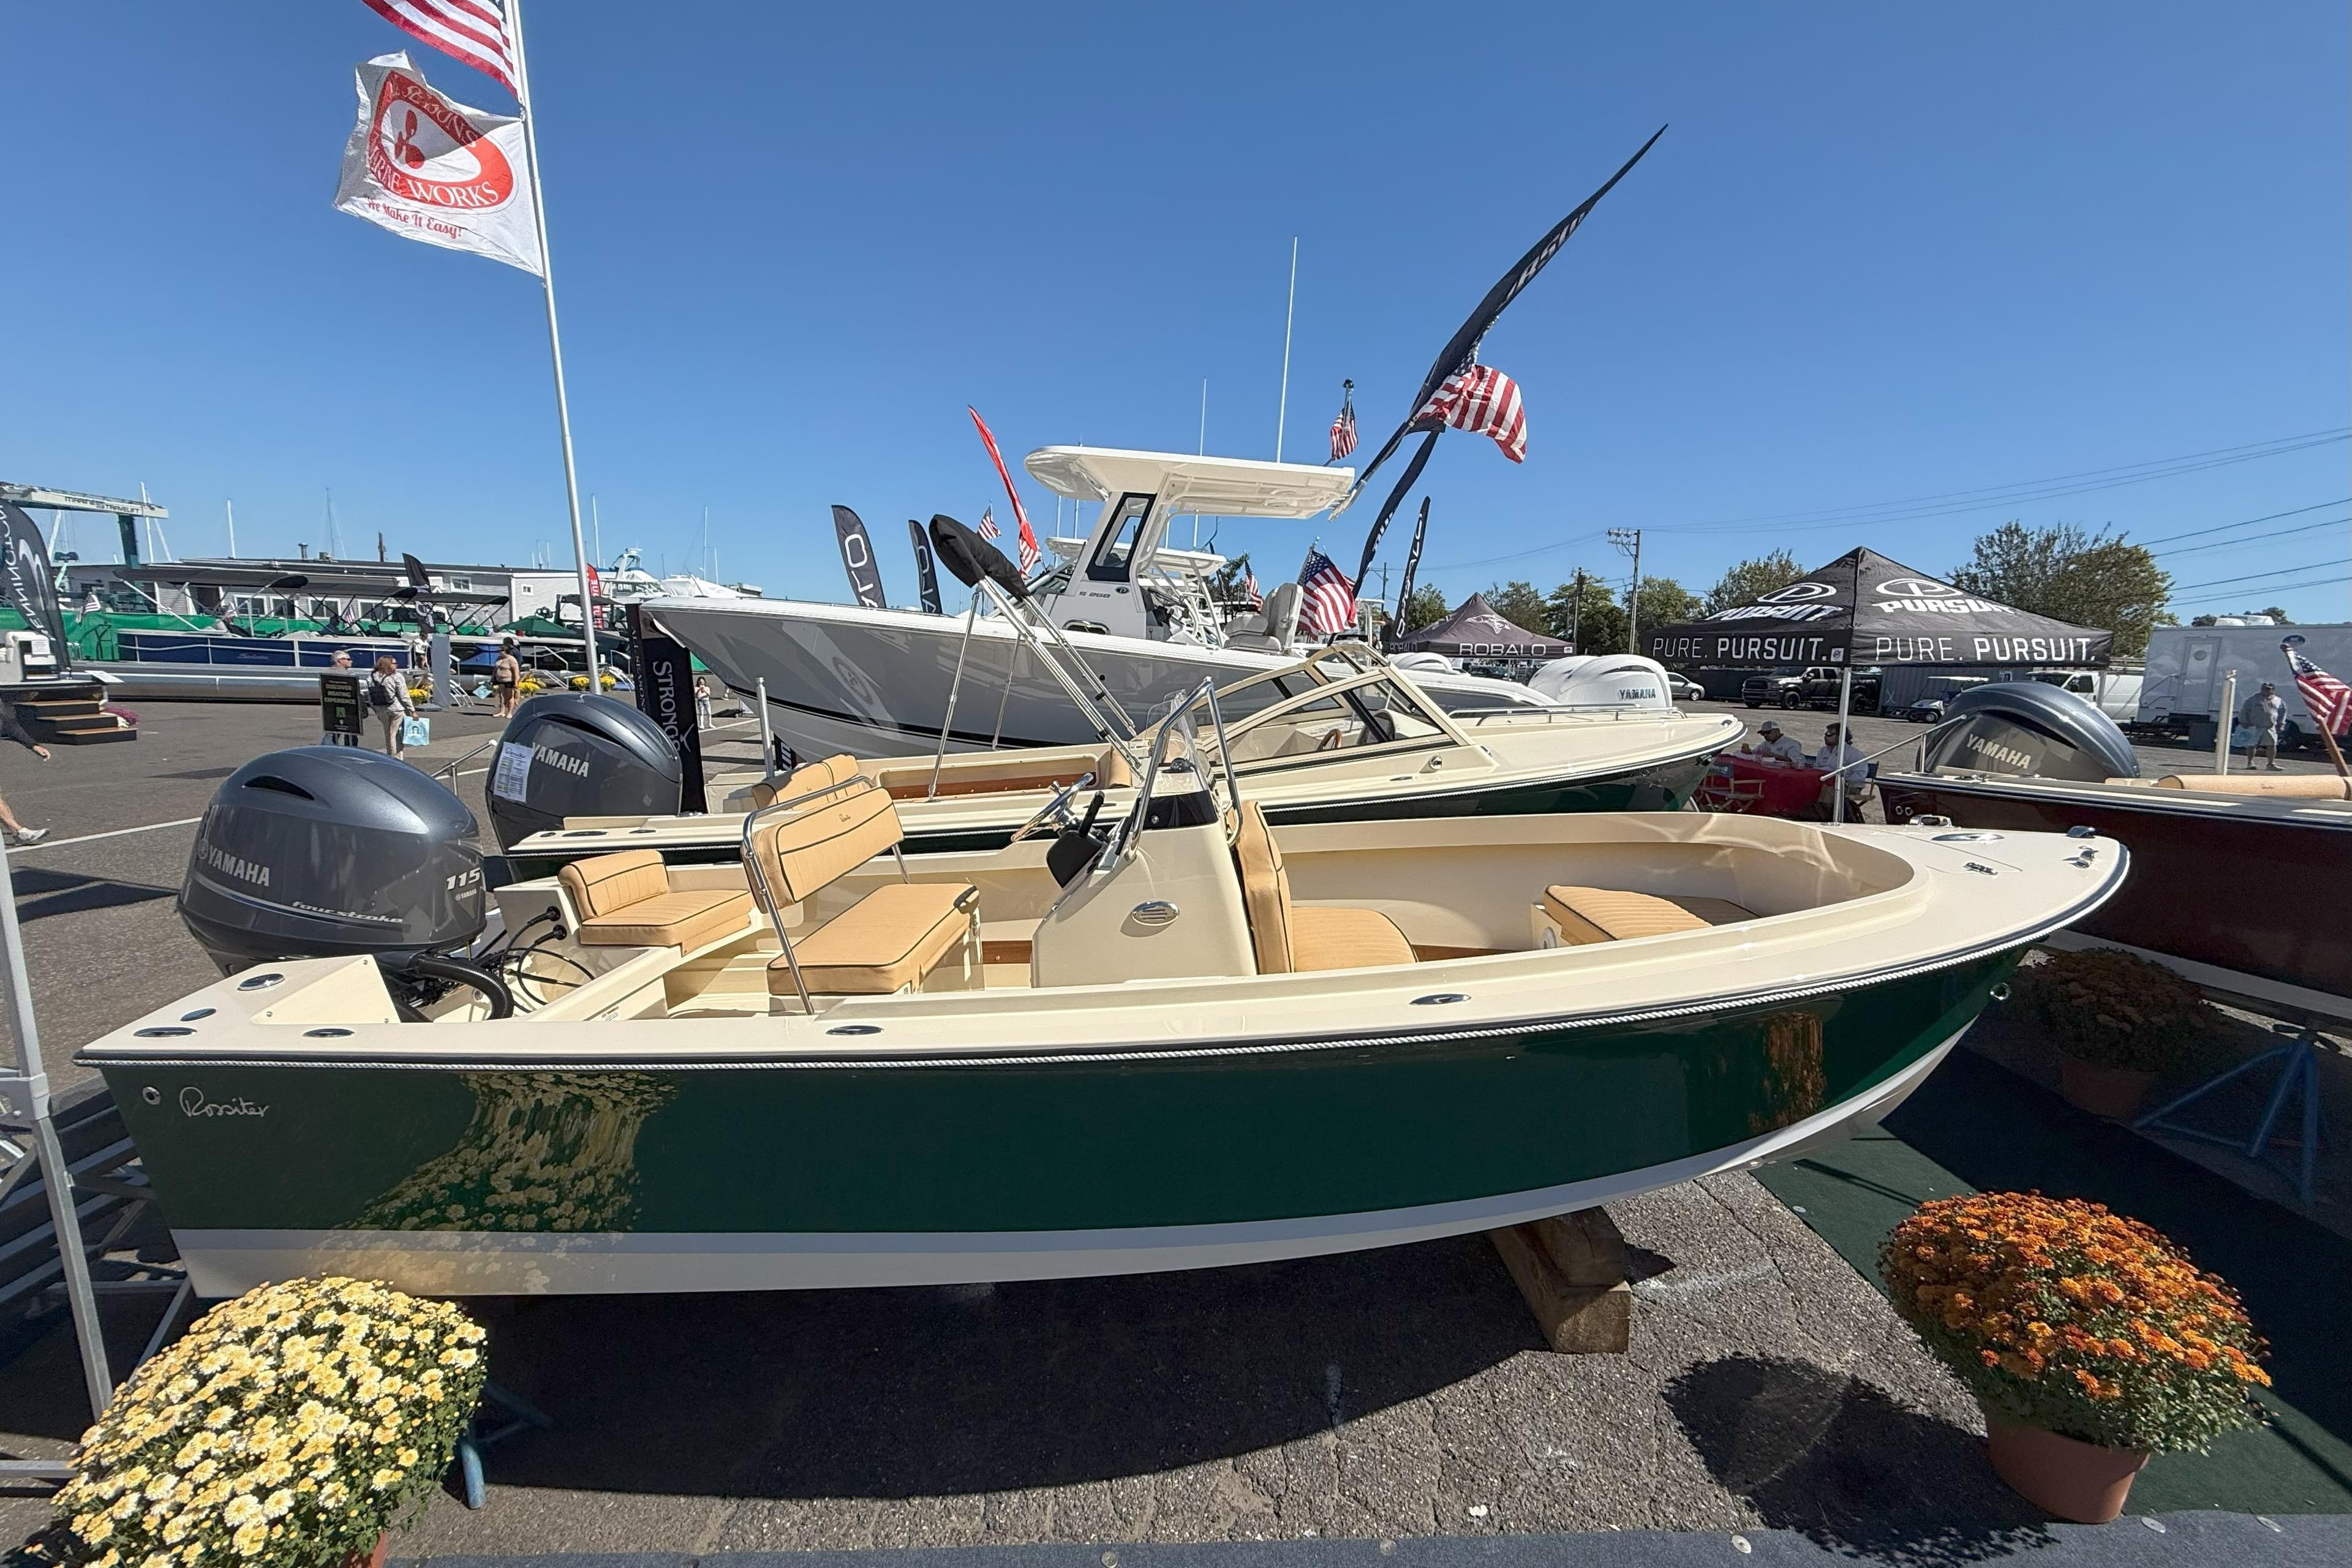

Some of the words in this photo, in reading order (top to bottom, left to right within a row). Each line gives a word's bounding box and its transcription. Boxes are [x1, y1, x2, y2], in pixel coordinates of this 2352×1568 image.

[406, 181, 499, 207] WORKS
[382, 204, 409, 224] Make
[412, 213, 423, 227] It
[426, 217, 462, 239] Easy!
[64, 496, 95, 505] MARINE
[106, 504, 140, 514] TRAVELIFT
[1705, 604, 1844, 621] PURSUIT
[1871, 599, 2015, 614] PURSUIT
[1459, 643, 1546, 657] ROBALO
[1653, 638, 1708, 658] PURE.
[1717, 638, 1827, 662] PURSUIT.
[1875, 637, 1963, 662] PURE.
[1973, 637, 2096, 662] PURSUIT.
[1618, 688, 1656, 699] YAMAHA
[531, 742, 590, 778] YAMAHA
[1966, 733, 2031, 769] YAMAHA
[208, 845, 270, 887] YAMAHA
[447, 867, 481, 891] 115
